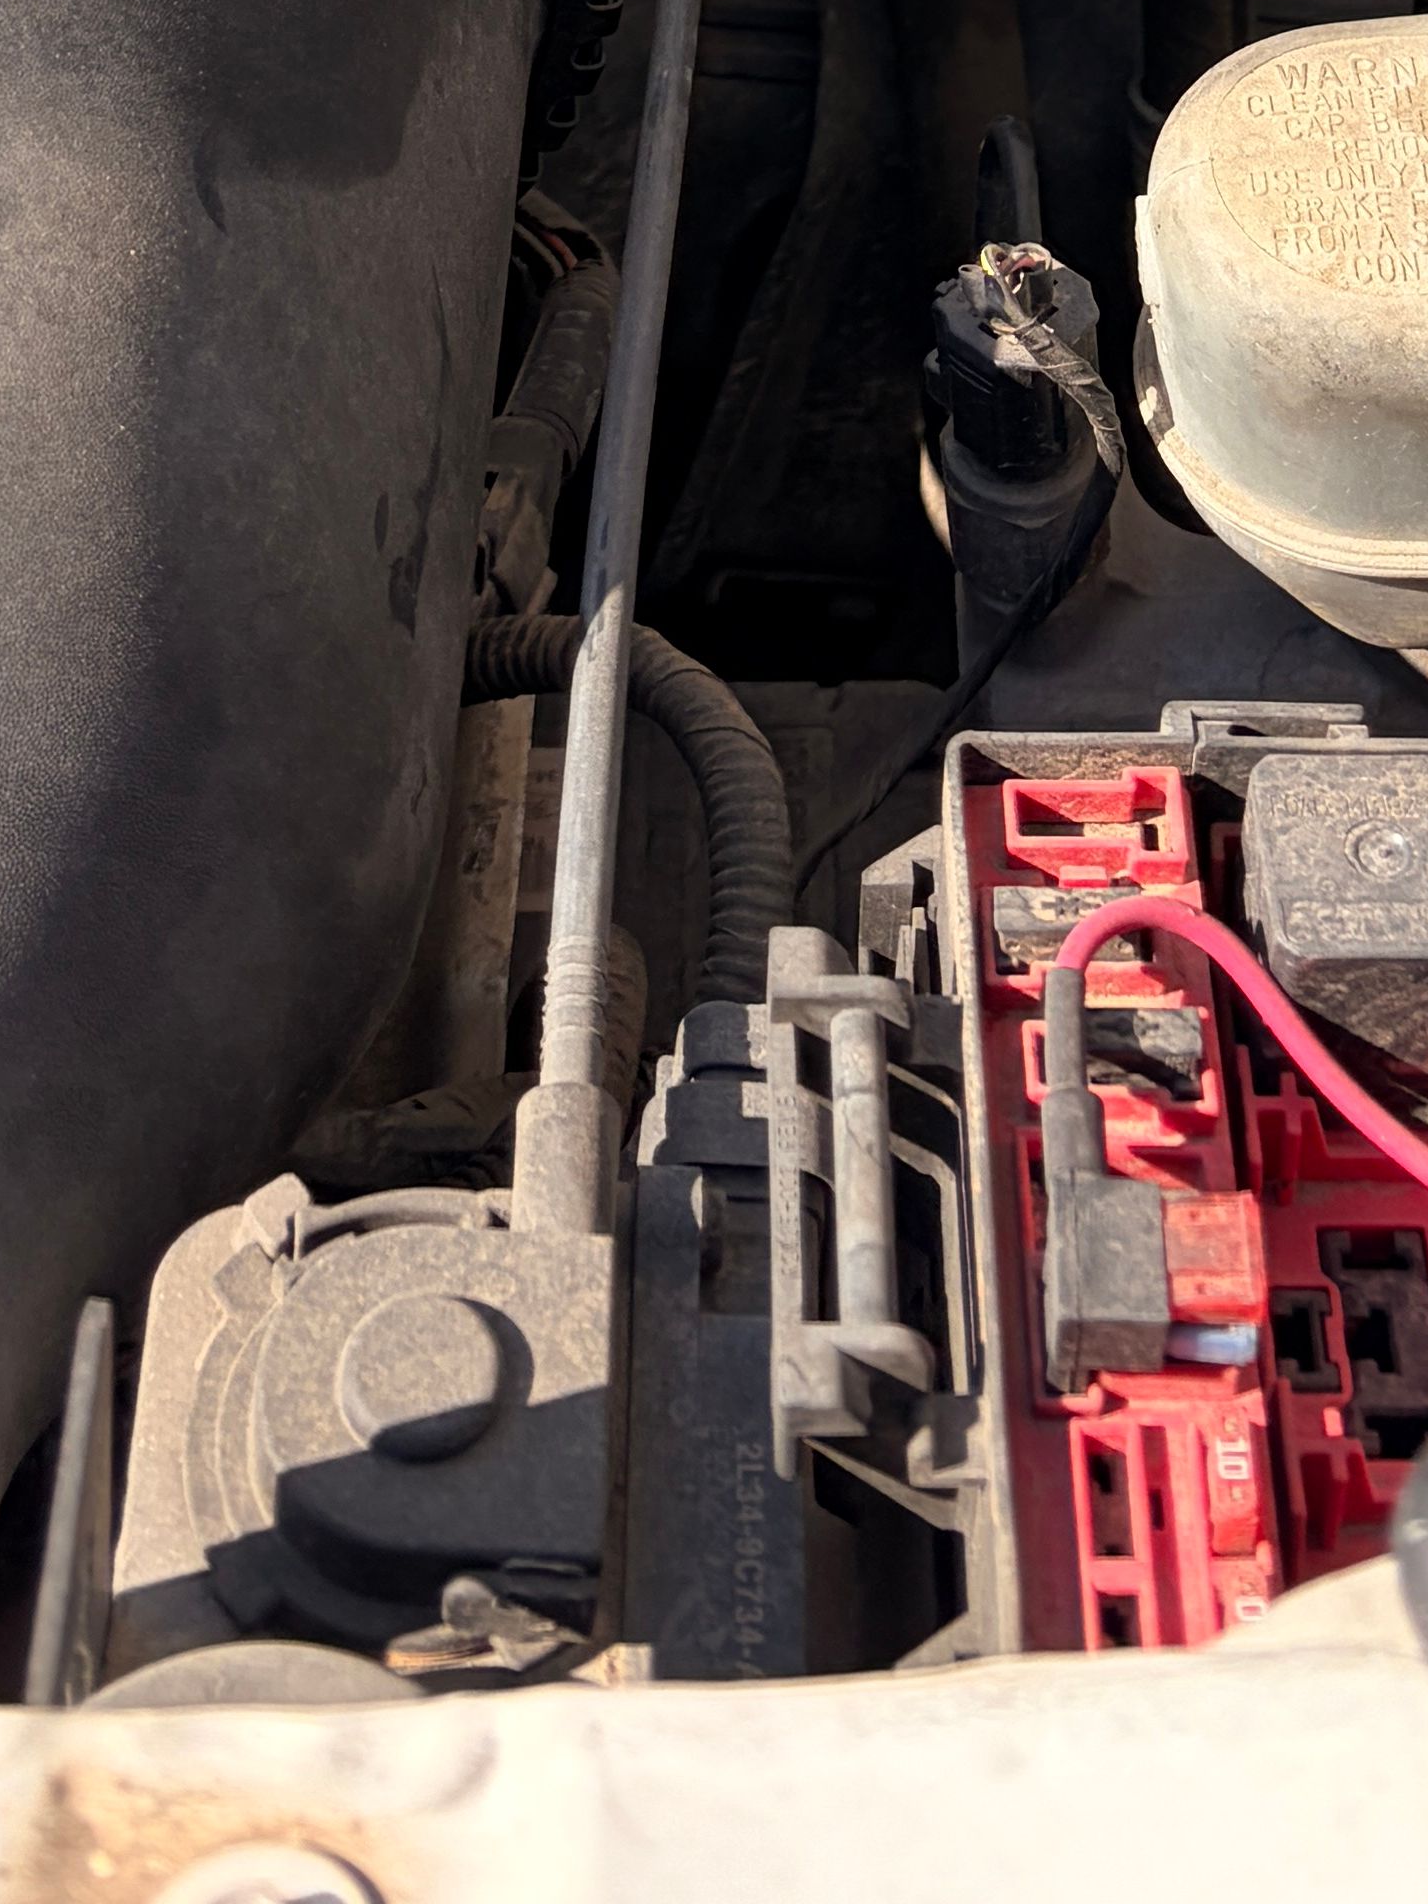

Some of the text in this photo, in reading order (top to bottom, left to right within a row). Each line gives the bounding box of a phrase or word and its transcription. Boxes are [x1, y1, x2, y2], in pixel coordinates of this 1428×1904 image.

[1248, 89, 1355, 118] CLEAN
[1285, 113, 1346, 140] CAP
[1250, 168, 1314, 196] USE
[1326, 162, 1407, 191] ONLY
[1284, 192, 1393, 223] BRAKE
[1273, 224, 1362, 256] FROM
[1379, 222, 1398, 251] A
[1215, 1436, 1251, 1480] 10
